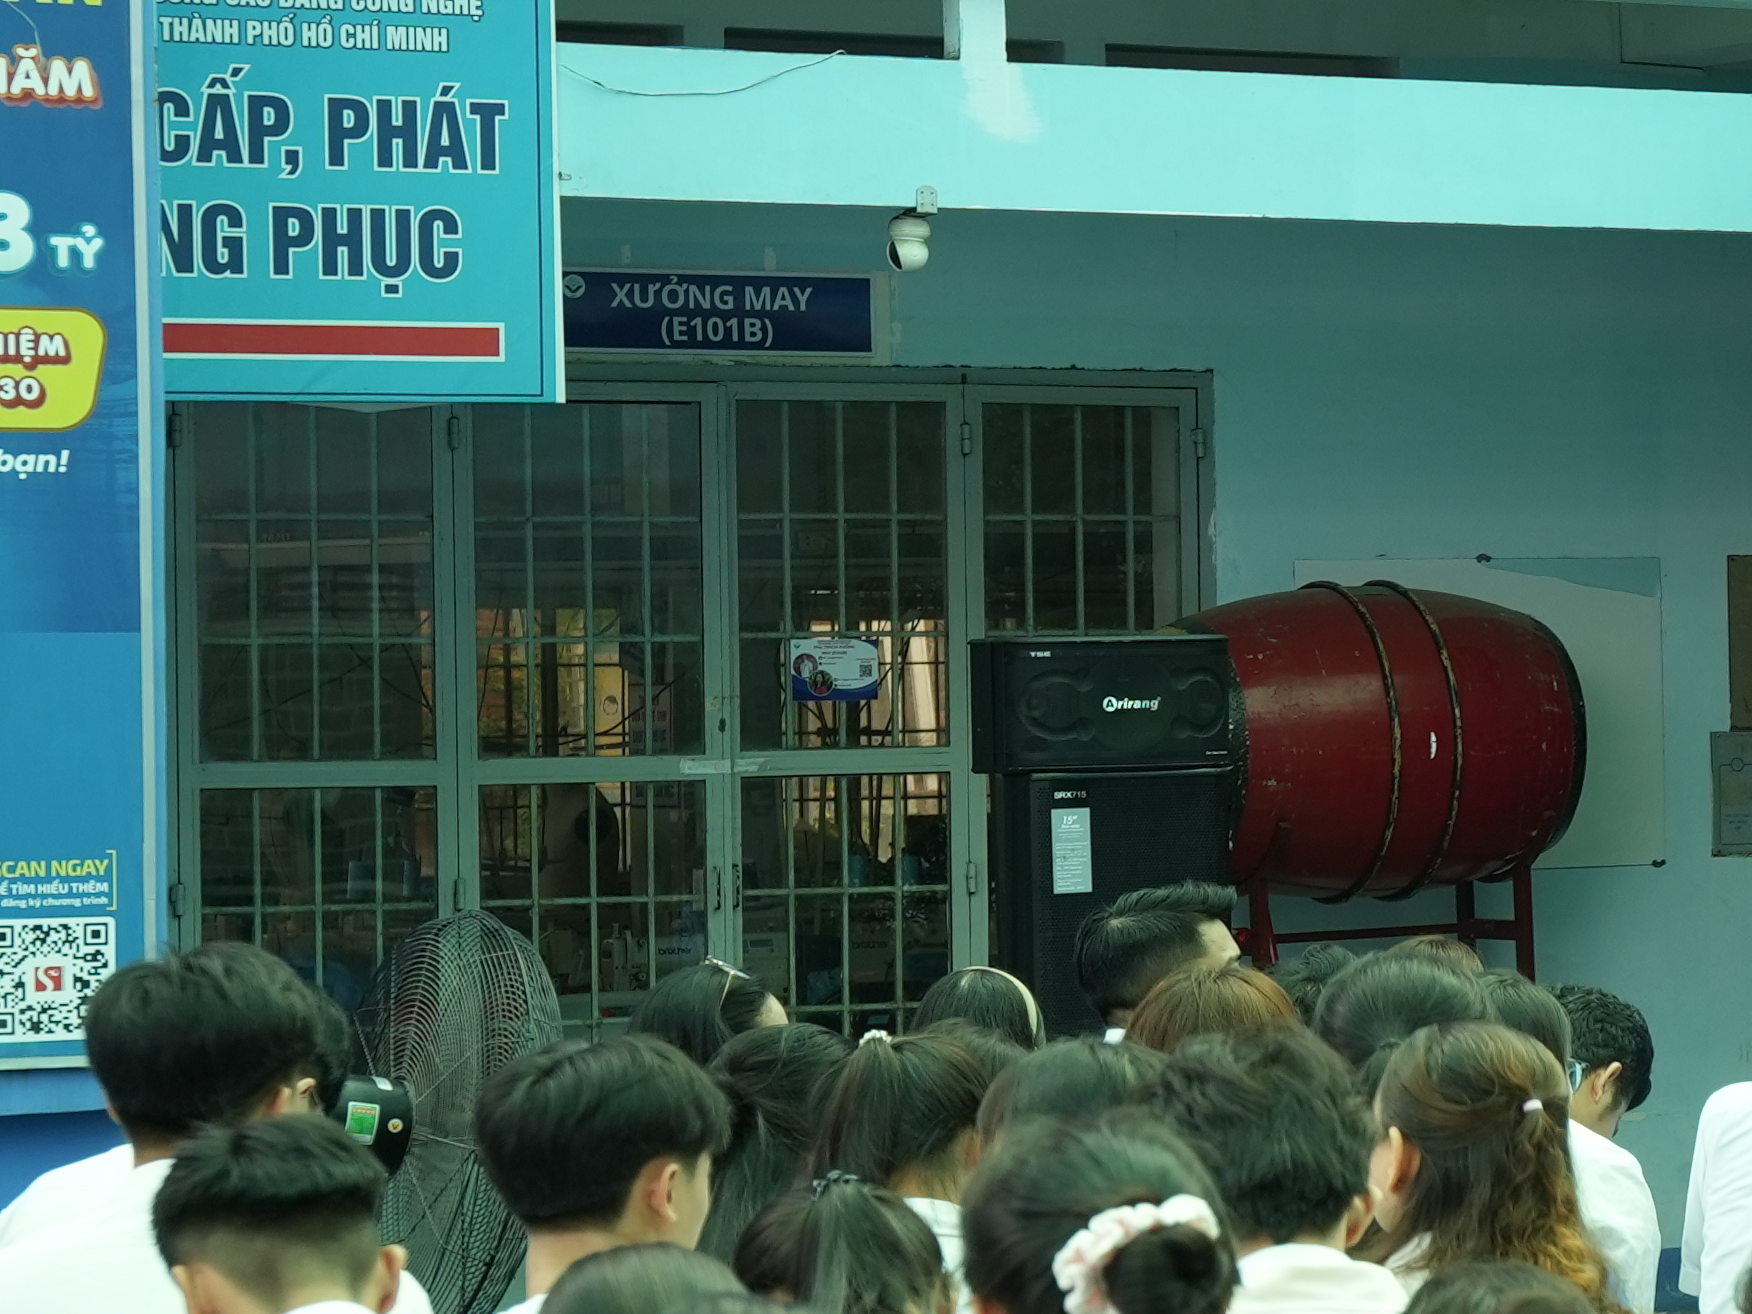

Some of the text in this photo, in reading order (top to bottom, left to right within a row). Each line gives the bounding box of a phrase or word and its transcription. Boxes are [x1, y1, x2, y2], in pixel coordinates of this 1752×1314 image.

[159, 11, 451, 54] THÀNH PHỐ HỒ CHÍ MINH
[156, 63, 509, 180] CẤP, PHÁT
[49, 224, 104, 271] TỶ
[268, 202, 463, 298] PHỤC
[610, 275, 813, 312] XƯỞNG MAY
[660, 316, 774, 348] (E101B)
[0, 448, 70, 481] bạn!
[1102, 695, 1160, 713] Arirang
[1053, 790, 1087, 800] SRX715
[0, 858, 110, 879] CAN NGAY
[657, 945, 693, 956] brother
